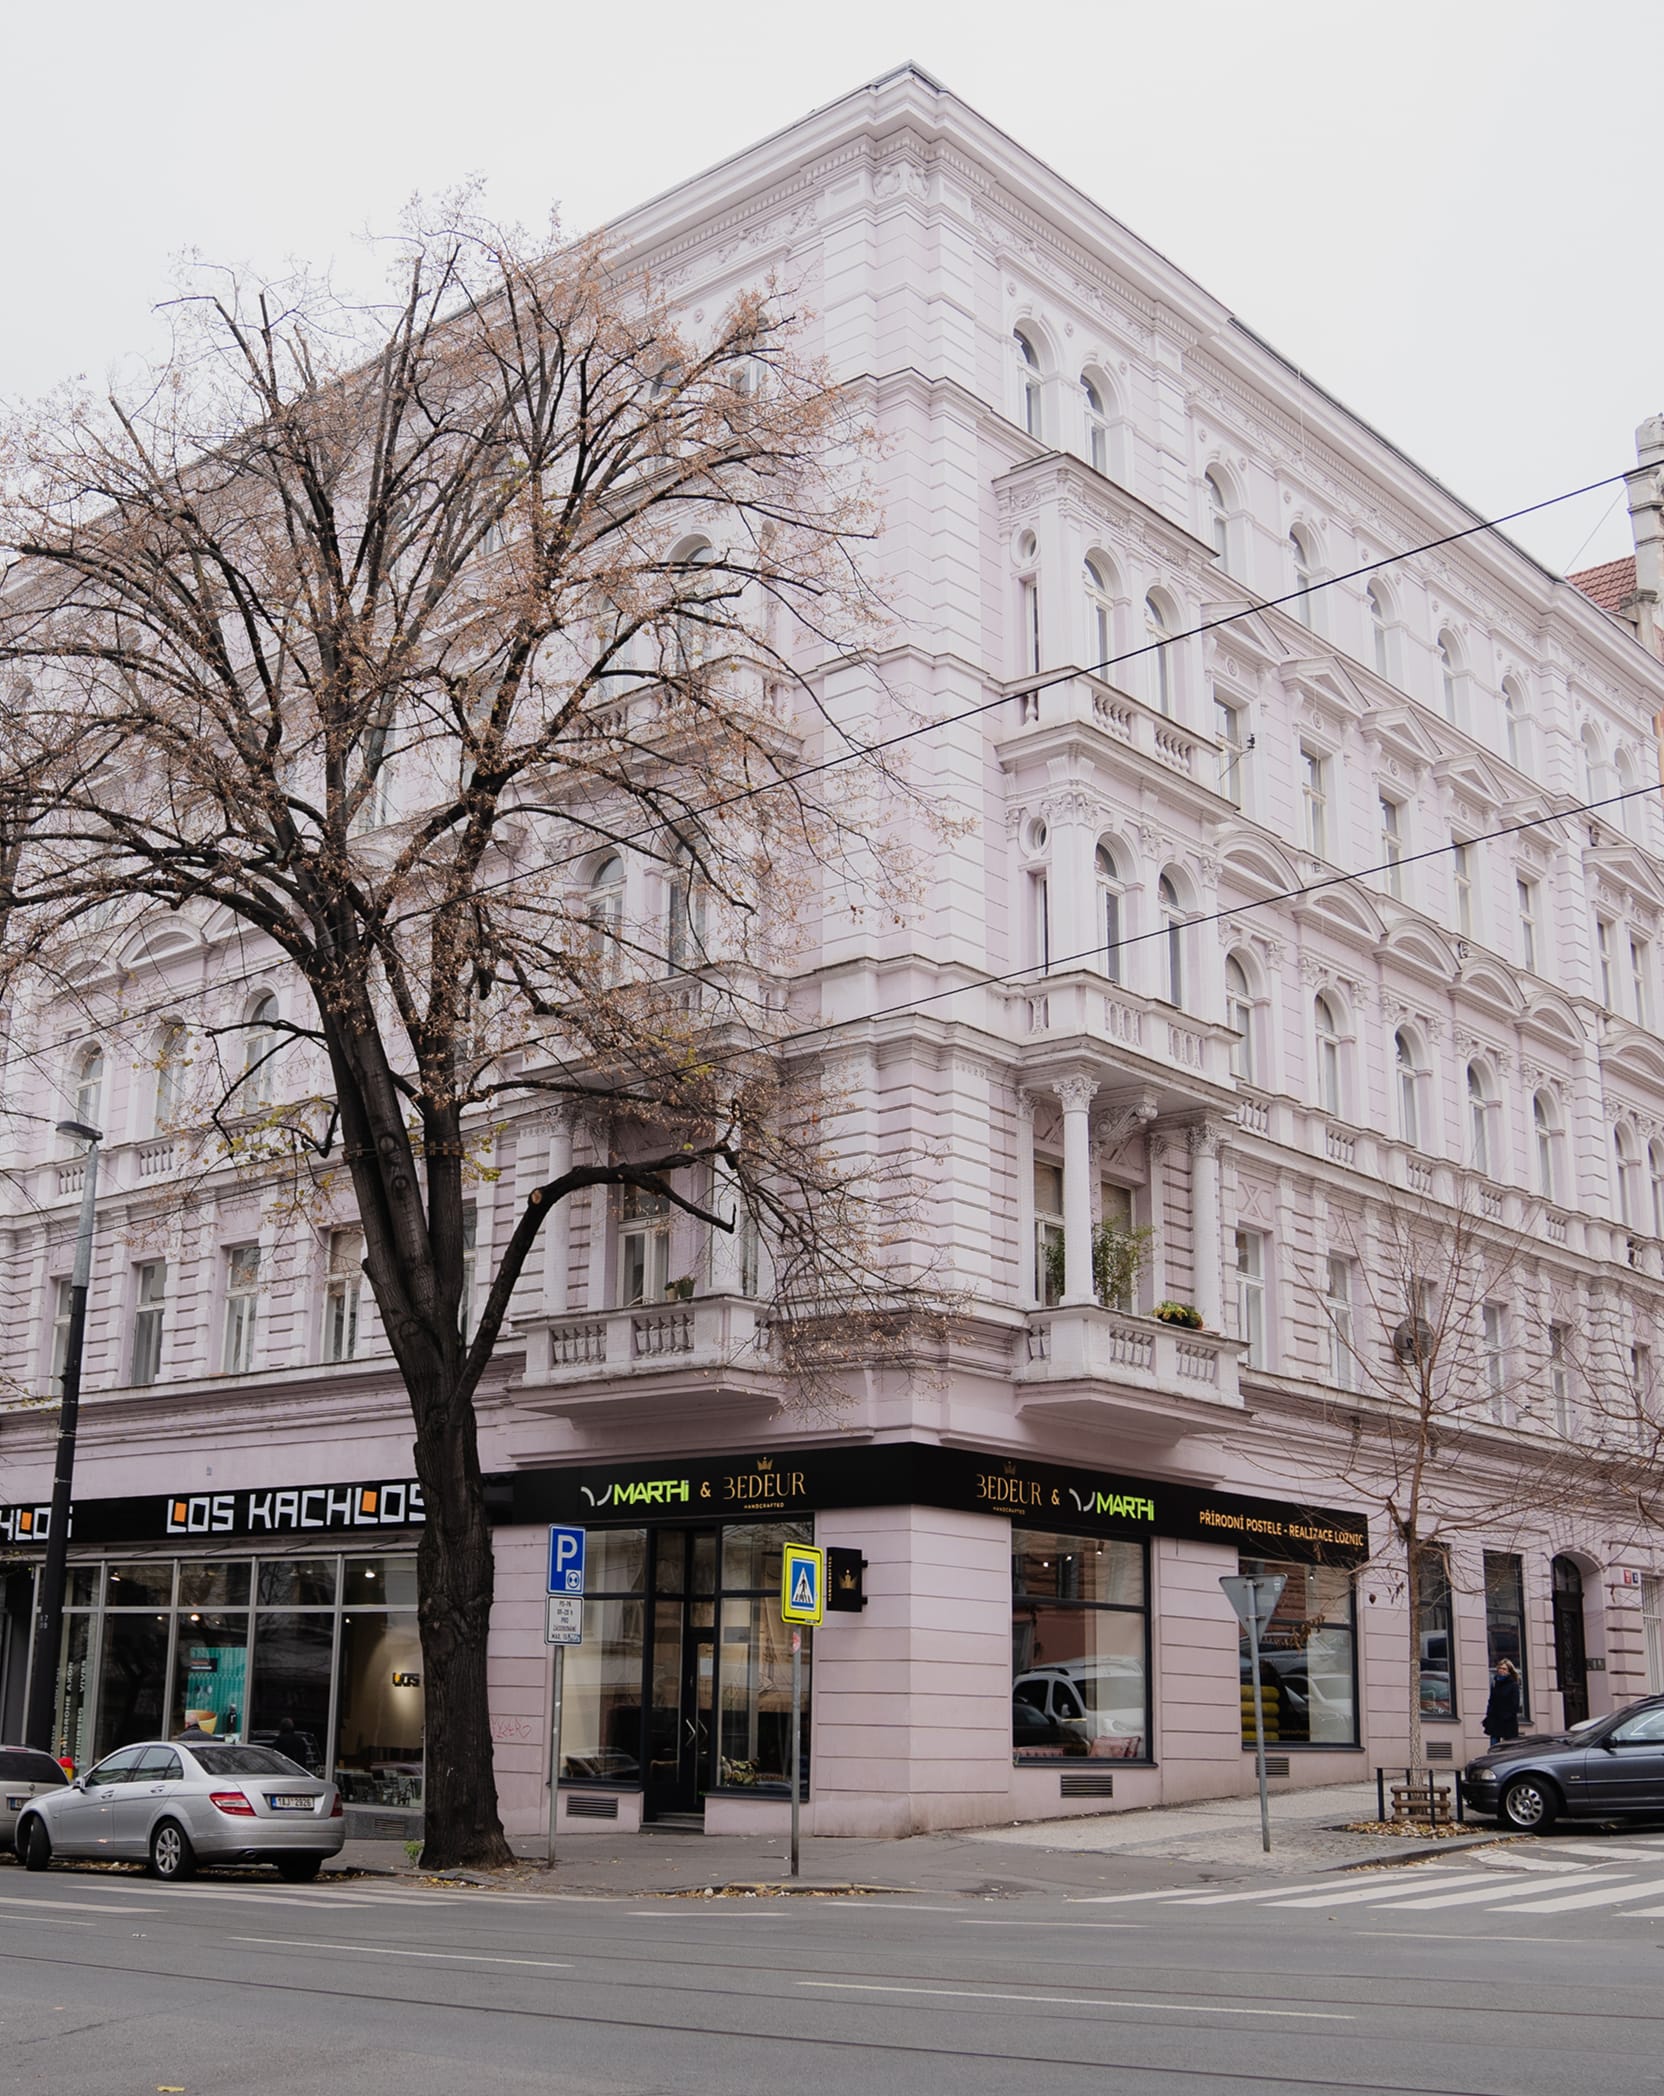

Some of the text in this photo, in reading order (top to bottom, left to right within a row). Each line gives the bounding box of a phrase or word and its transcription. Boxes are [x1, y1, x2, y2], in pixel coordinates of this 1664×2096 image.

[700, 1481, 711, 1498] &
[723, 1472, 806, 1500] BEDEUR
[976, 1474, 1042, 1506] BEDEUR
[1051, 1489, 1060, 1505] &
[0, 1505, 73, 1541] HLO
[167, 1483, 426, 1533] LOS KACHLOS
[1246, 1519, 1282, 1535] POSTELE
[1289, 1524, 1334, 1542] REALIZACE
[557, 1534, 578, 1572] P
